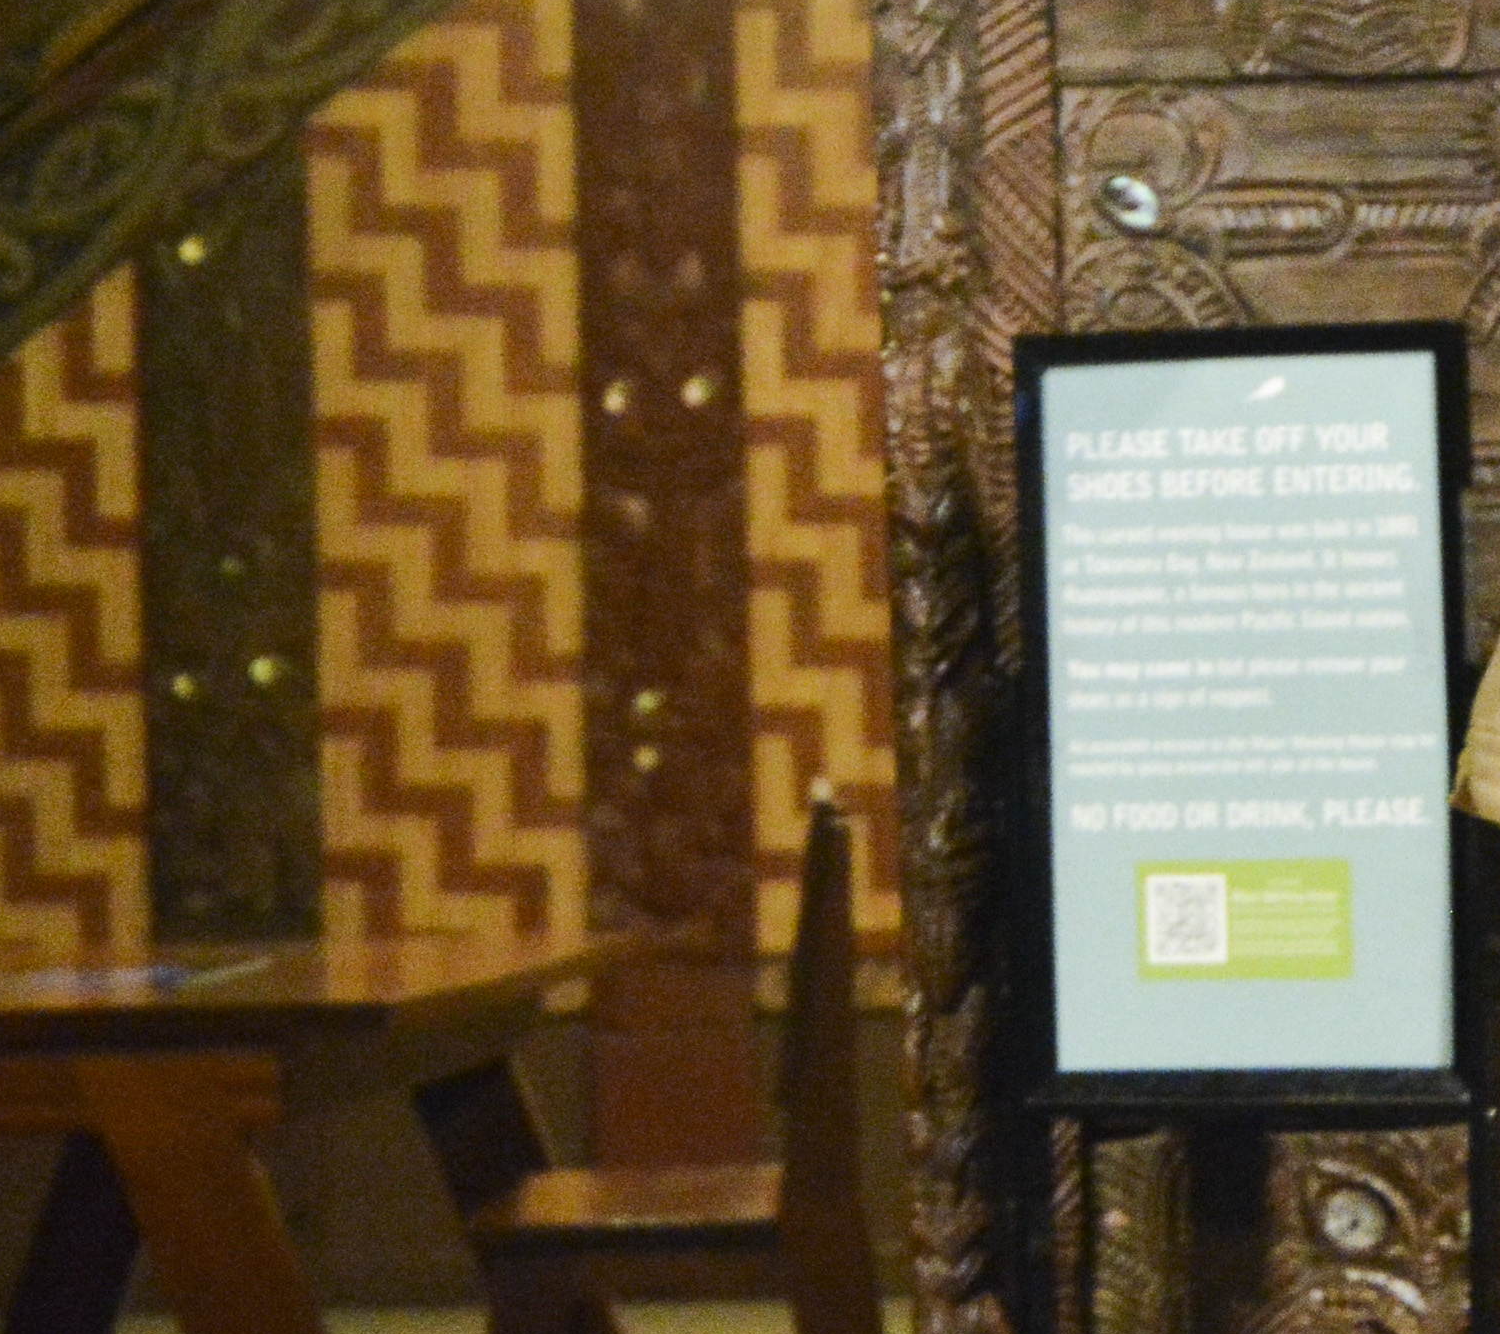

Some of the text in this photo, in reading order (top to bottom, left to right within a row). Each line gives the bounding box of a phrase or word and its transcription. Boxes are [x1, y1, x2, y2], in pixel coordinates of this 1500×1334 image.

[1066, 421, 1389, 459] PLEASE TAKE OFF YOUR
[1067, 463, 1420, 501] SHOES BEFORE ENTERING.
[1071, 796, 1431, 831] NO FOOD OR DRINK, PLEASE.
